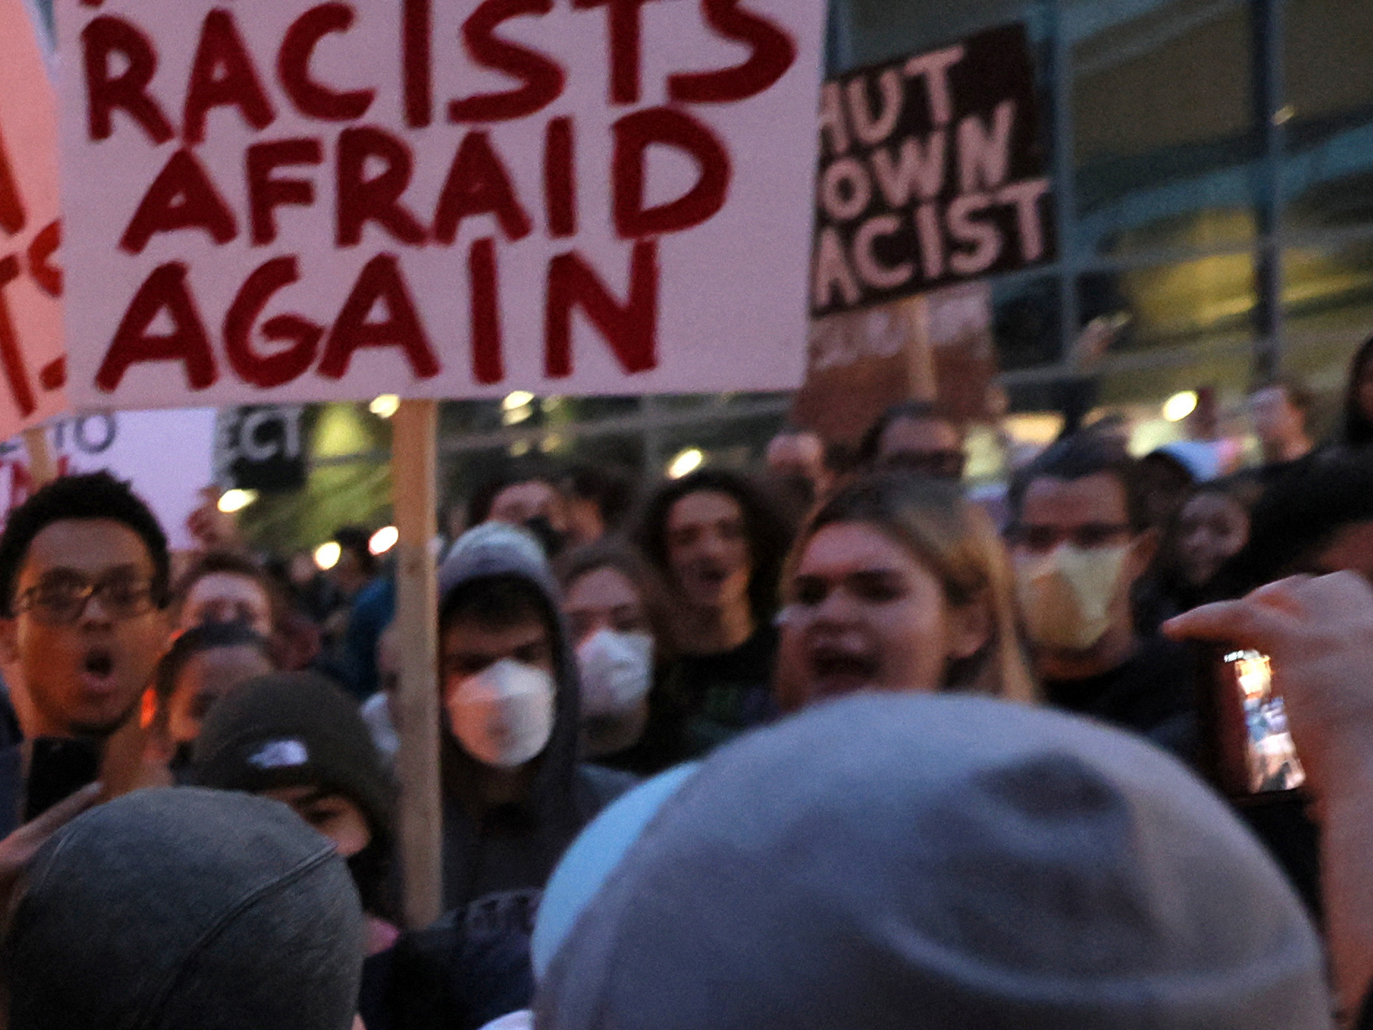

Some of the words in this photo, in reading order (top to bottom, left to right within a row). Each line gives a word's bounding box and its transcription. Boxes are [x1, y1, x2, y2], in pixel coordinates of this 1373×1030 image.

[80, 0, 798, 147] RACISTS
[117, 107, 733, 255] AFRAID
[95, 236, 661, 393] AGAIN
